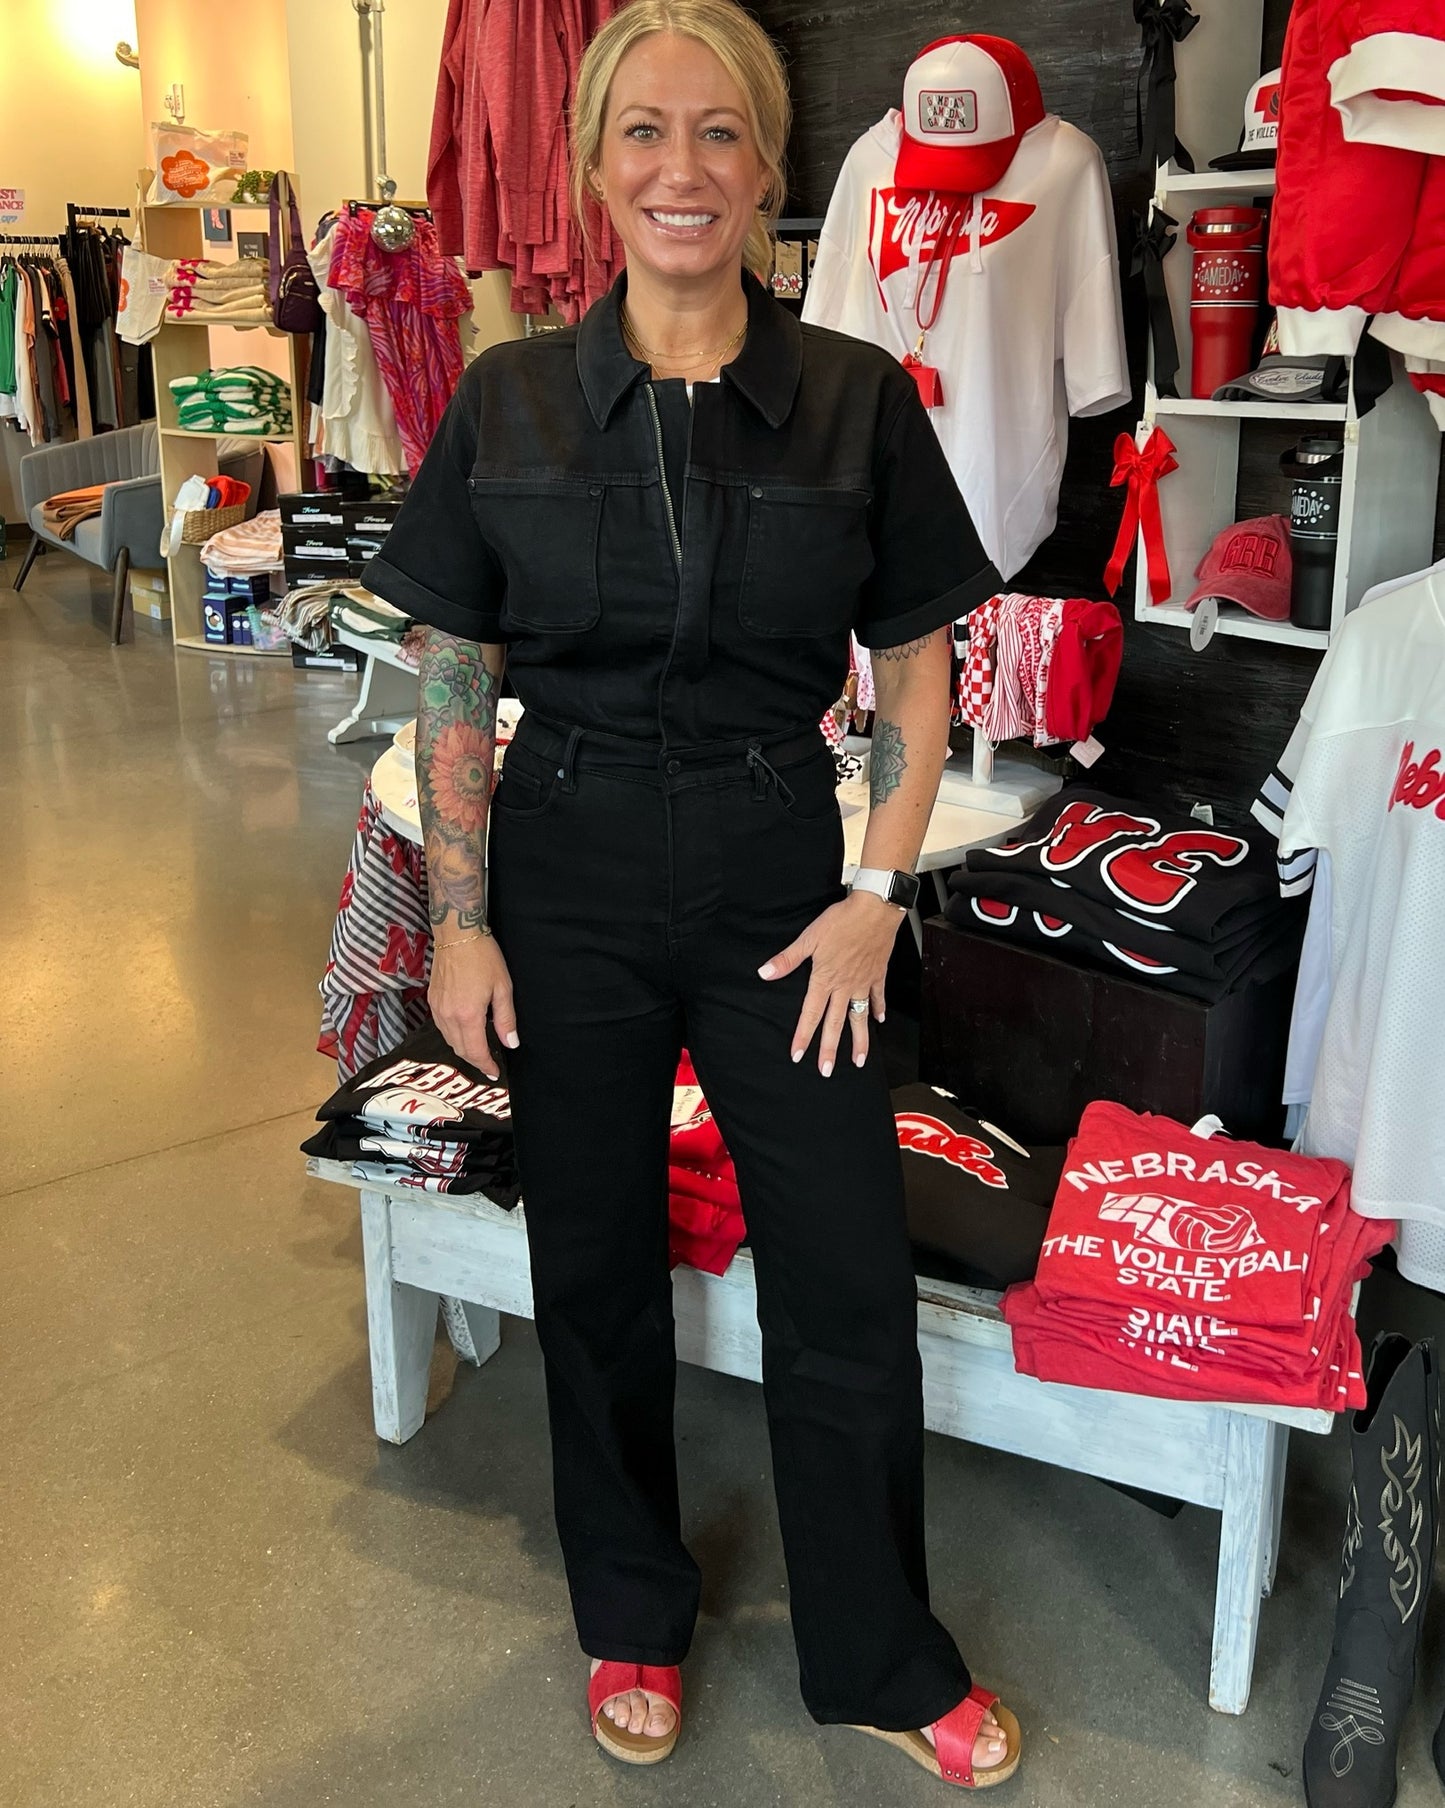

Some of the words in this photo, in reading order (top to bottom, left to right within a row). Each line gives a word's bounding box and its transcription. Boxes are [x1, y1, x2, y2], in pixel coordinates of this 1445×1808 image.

[926, 95, 966, 109] GAMEDAY
[927, 106, 966, 120] GAMEDAY
[927, 116, 967, 130] GAMEDAY
[1198, 266, 1243, 287] GAMEDAY
[400, 1098, 425, 1114] N
[1064, 1151, 1323, 1214] NEBRASKA
[1042, 1234, 1103, 1258] THE
